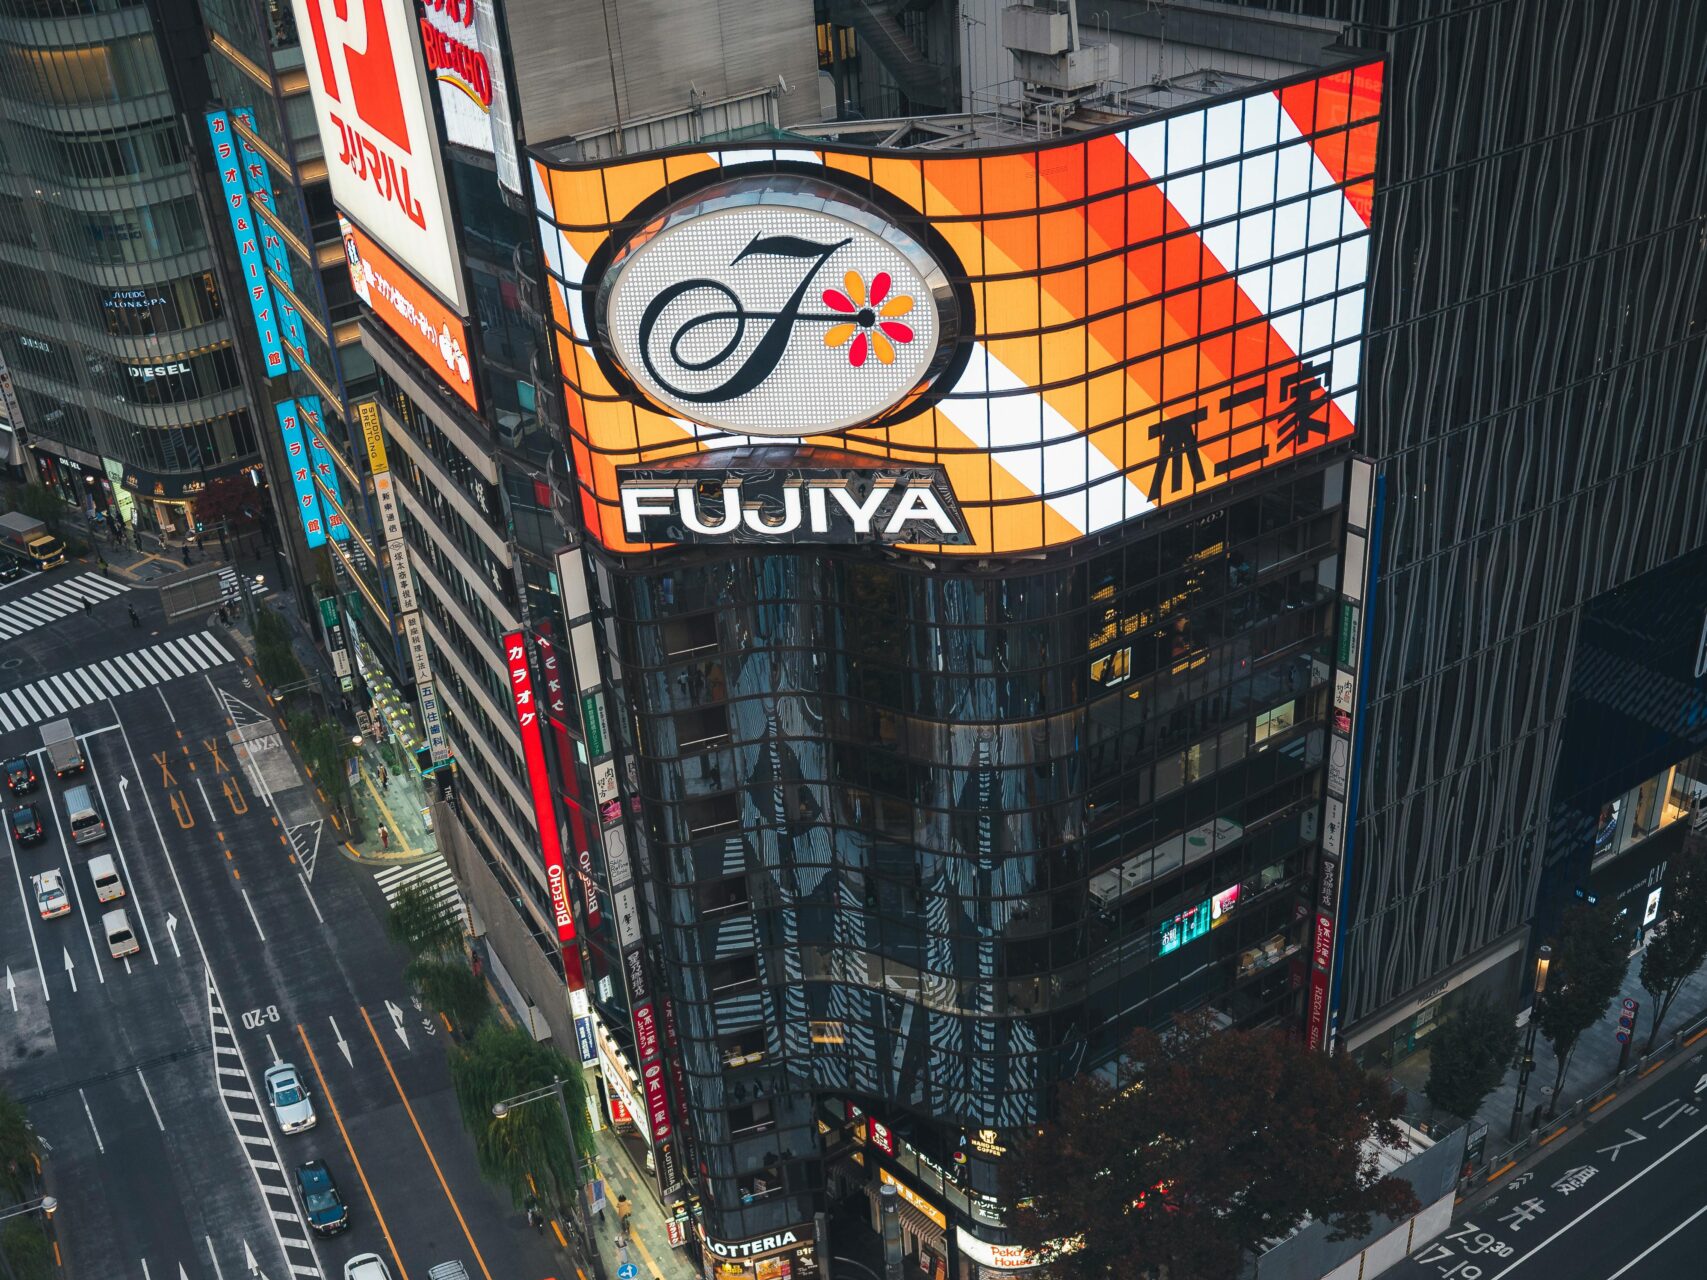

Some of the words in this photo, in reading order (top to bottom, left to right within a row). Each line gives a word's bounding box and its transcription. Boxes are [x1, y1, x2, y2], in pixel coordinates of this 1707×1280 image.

[330, 112, 426, 231] プリマハム
[128, 363, 191, 377] DIESEL
[361, 408, 377, 459] BREITLING
[368, 406, 381, 441] STUDIO
[1147, 360, 1332, 503] 不二家
[284, 416, 320, 533] カラオケ館
[621, 483, 957, 535] FUJIYA
[508, 645, 536, 726] カラオケ
[421, 687, 443, 747] 五百住歯科
[548, 864, 563, 901] ECHO
[555, 901, 572, 927] BIG
[242, 1005, 280, 1029] 8-20
[1312, 985, 1323, 1023] REGAL
[649, 1078, 666, 1124] 不二家
[665, 1151, 676, 1186] LOTTERIA
[706, 1231, 797, 1257] LOTTERIA
[796, 1247, 814, 1256] B1F
